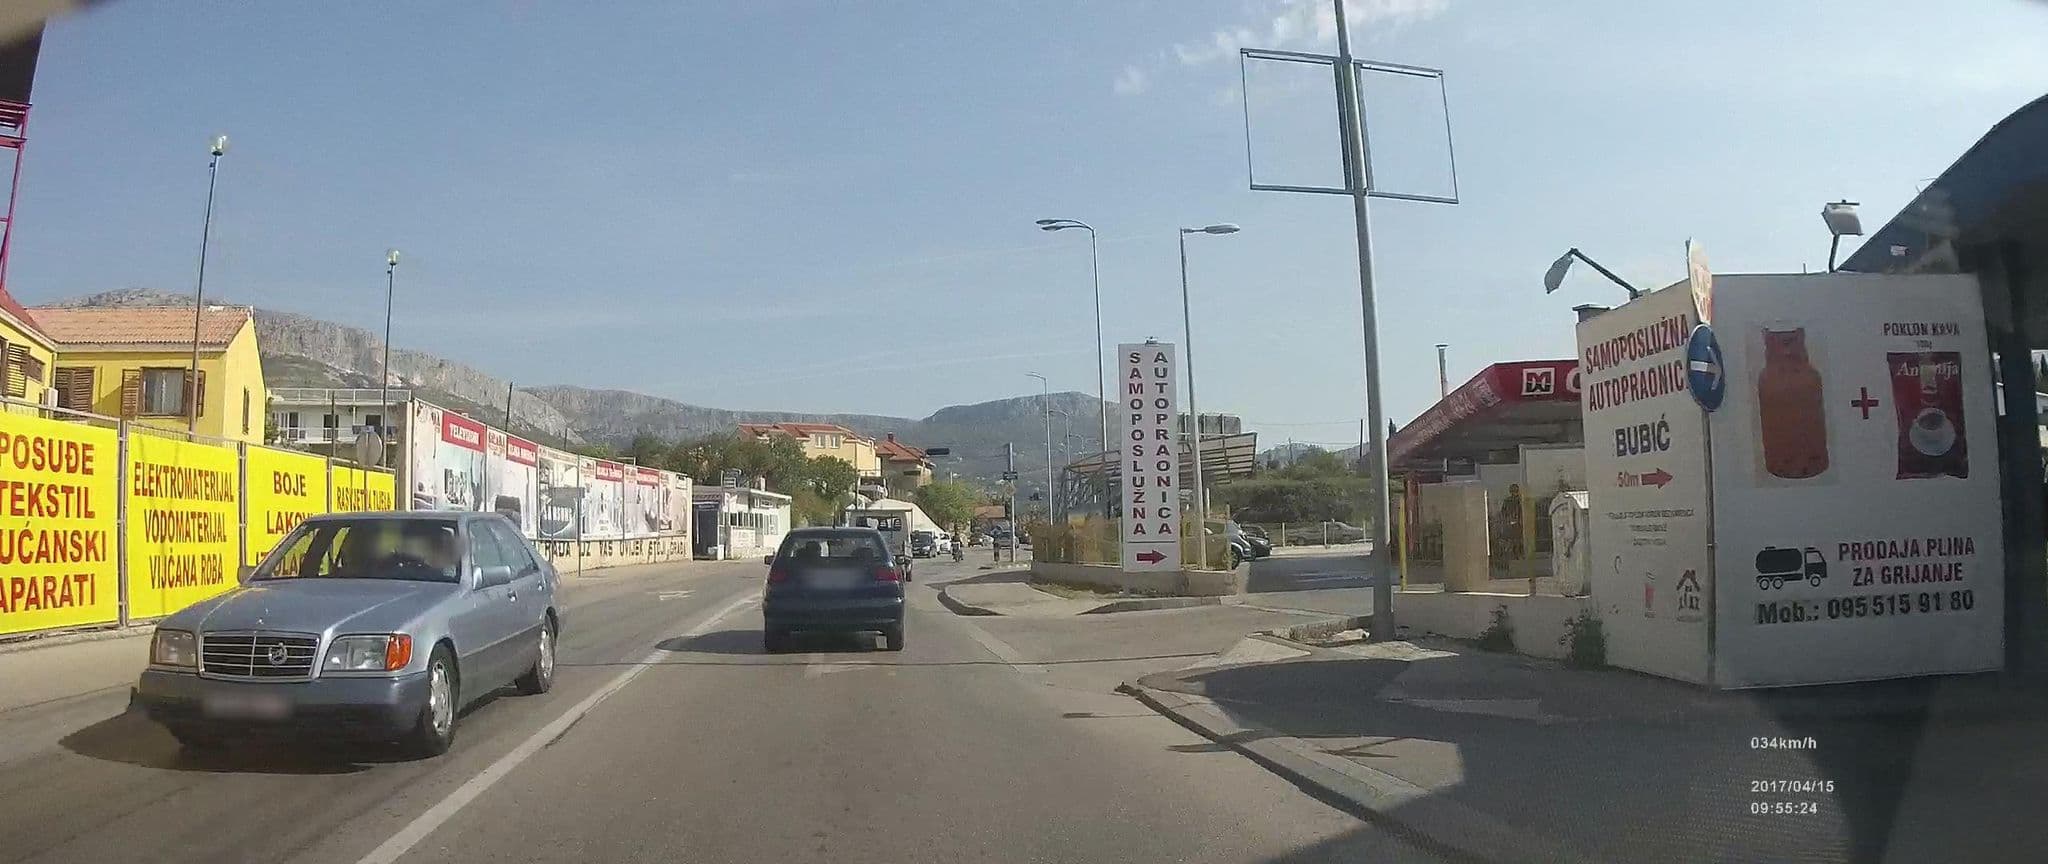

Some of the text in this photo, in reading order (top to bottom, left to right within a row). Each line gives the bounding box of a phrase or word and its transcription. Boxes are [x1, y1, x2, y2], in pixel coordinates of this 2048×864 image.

[1586, 314, 1689, 375] SAMOPOSLUŽNA
[1883, 322, 1960, 336] POKLON KAVA
[1589, 359, 1689, 412] AUTOPRAONIC
[1154, 351, 1172, 534] AUTOPRAONICA
[1615, 412, 1670, 457] BUBIĆ
[134, 461, 234, 503] ELEKTROMATERIJAL
[273, 470, 307, 497] BOJE
[144, 508, 227, 543] VODOMATERIJAL
[1838, 537, 1975, 560] PRODAJA PLINA
[201, 553, 223, 586] ROBA
[1852, 562, 1963, 587] ZA GRIJANJE
[1828, 597, 1868, 619] 095
[1872, 594, 1911, 615] 515
[1919, 592, 1943, 613] 91
[1950, 589, 1975, 611] 80
